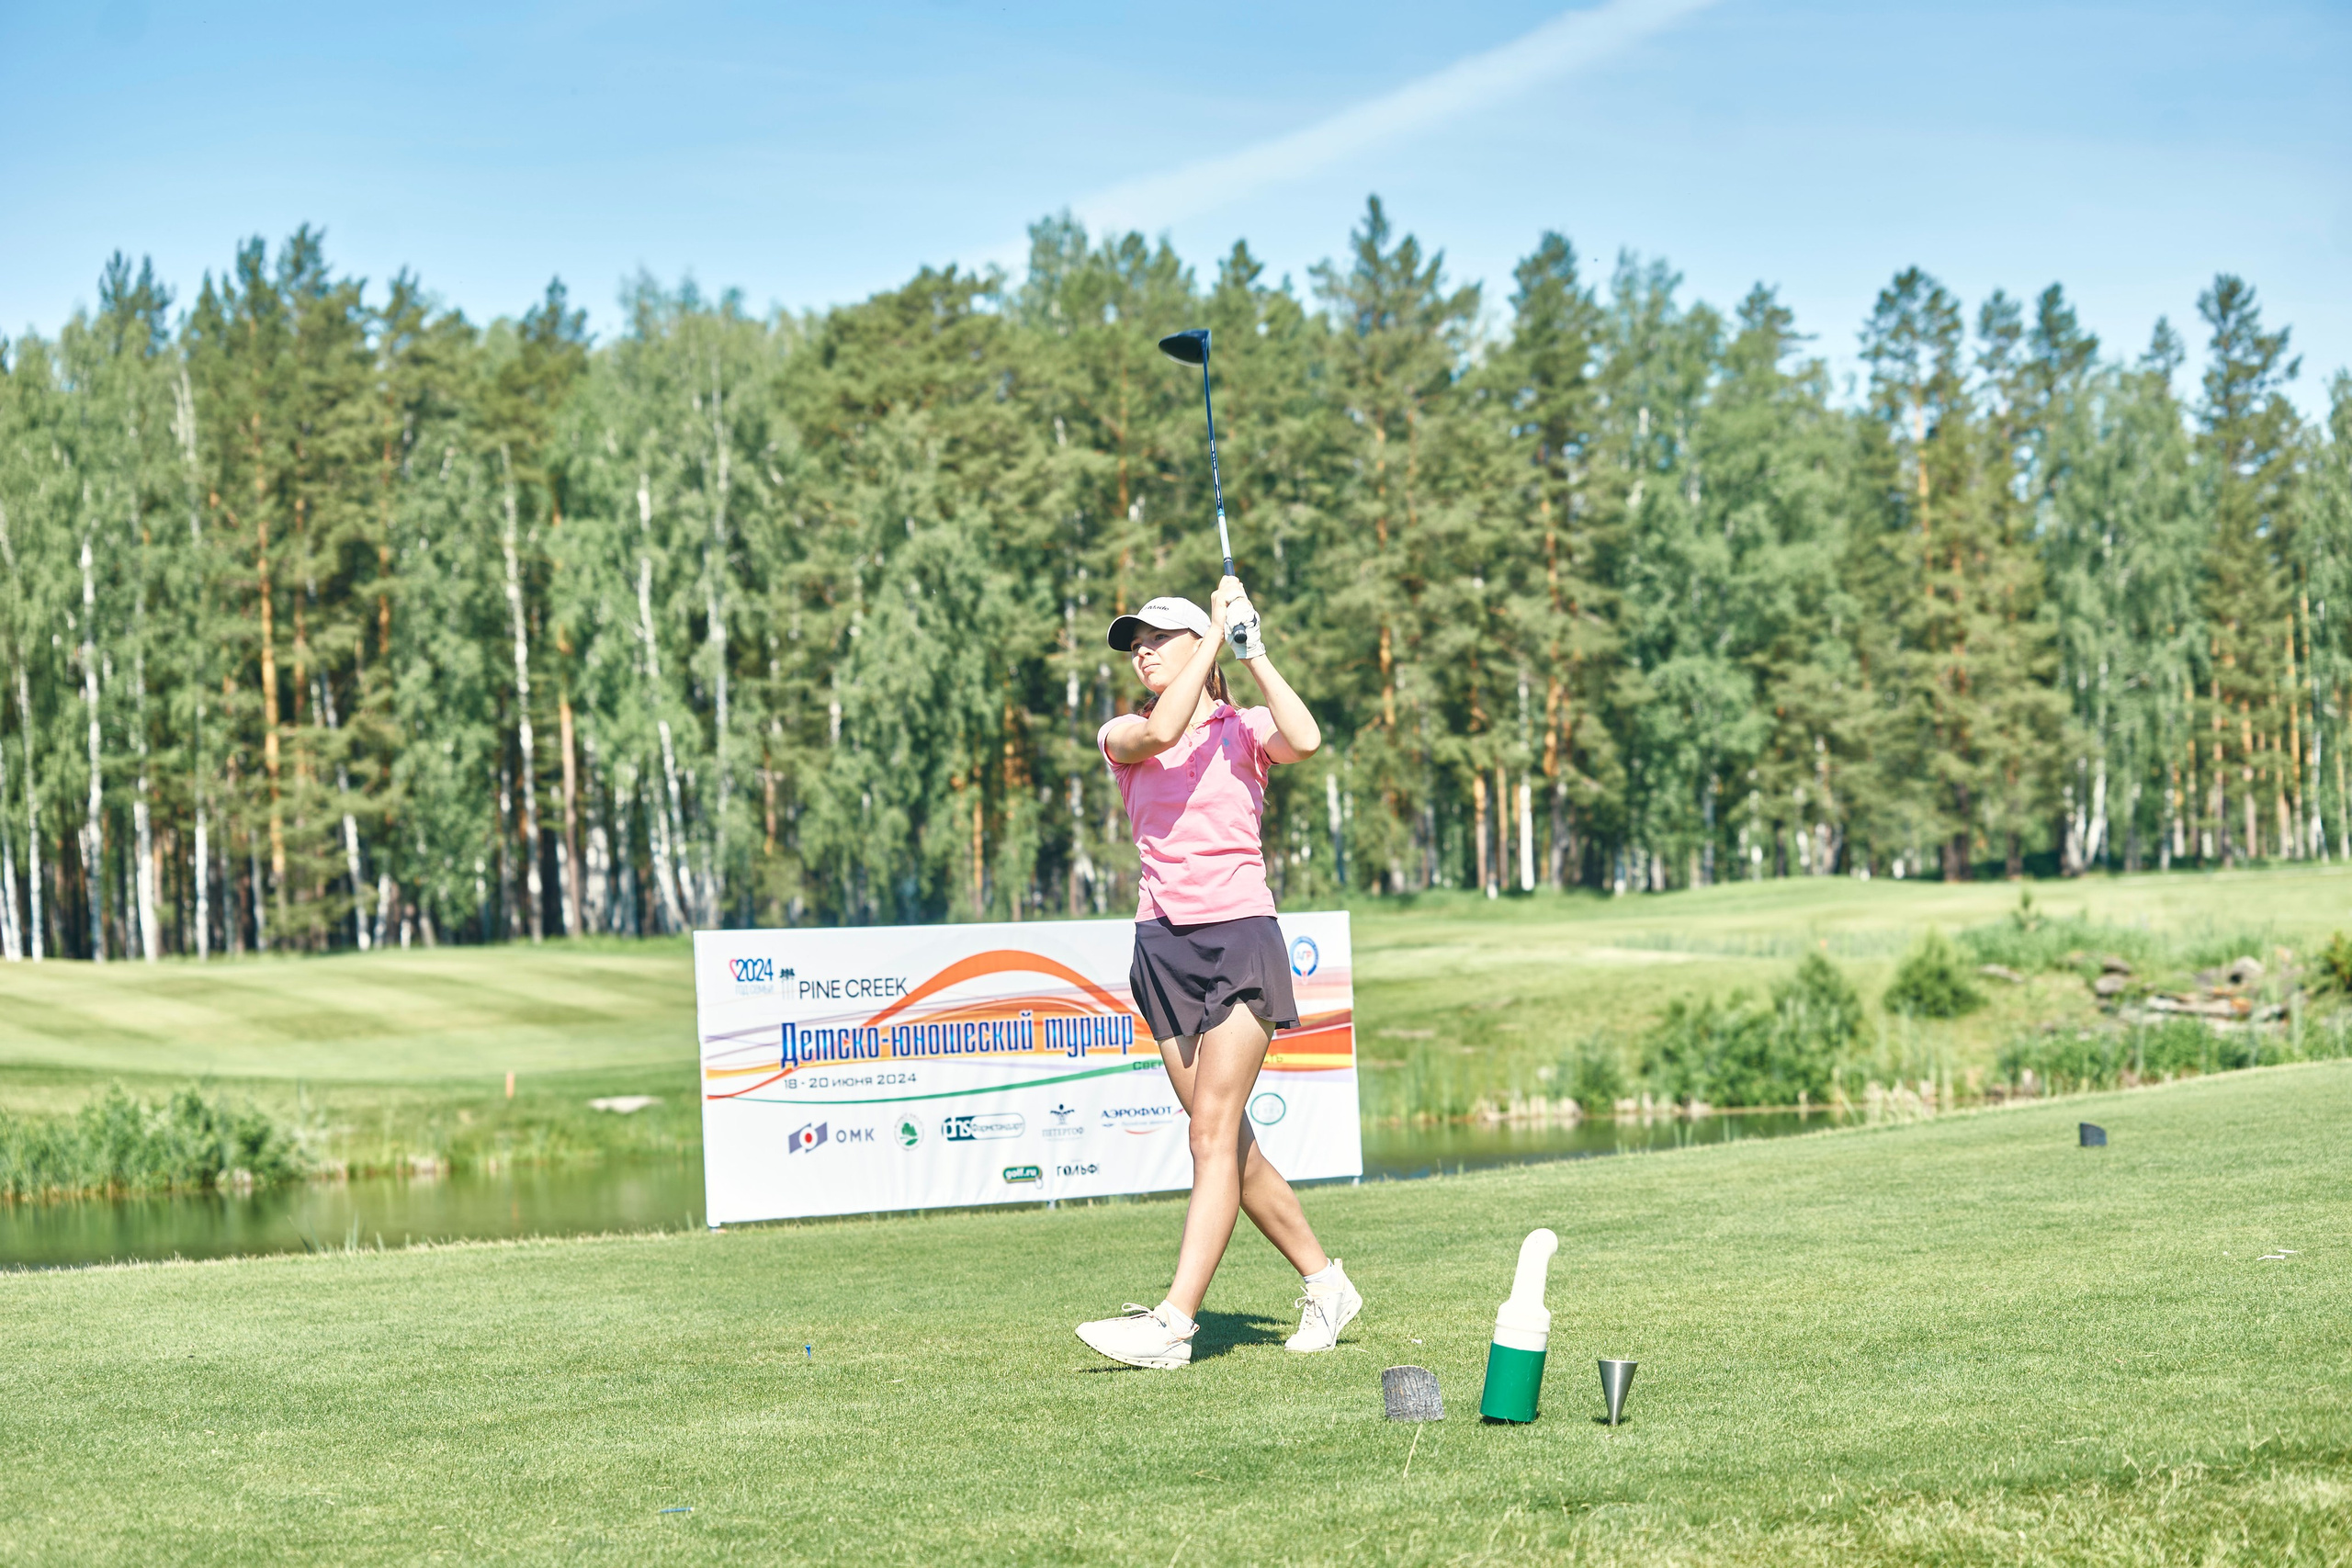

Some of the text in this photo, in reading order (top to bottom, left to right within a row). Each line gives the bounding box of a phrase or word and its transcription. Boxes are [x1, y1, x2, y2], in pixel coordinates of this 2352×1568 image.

[735, 958, 774, 982] 2024
[798, 976, 909, 999] PINE CREEK
[780, 1012, 1134, 1069] Детско-юношеский турнир
[785, 1078, 797, 1089] 18
[809, 1077, 828, 1089] 20
[876, 1073, 917, 1085] 2024
[1101, 1105, 1172, 1119] АЭРОФЛОТ
[836, 1128, 875, 1143] ОМК
[1042, 1126, 1084, 1138] ПЕТЕРГОФ
[1005, 1168, 1037, 1180] golf.ru
[1057, 1164, 1097, 1177] ГОЛЬФ
